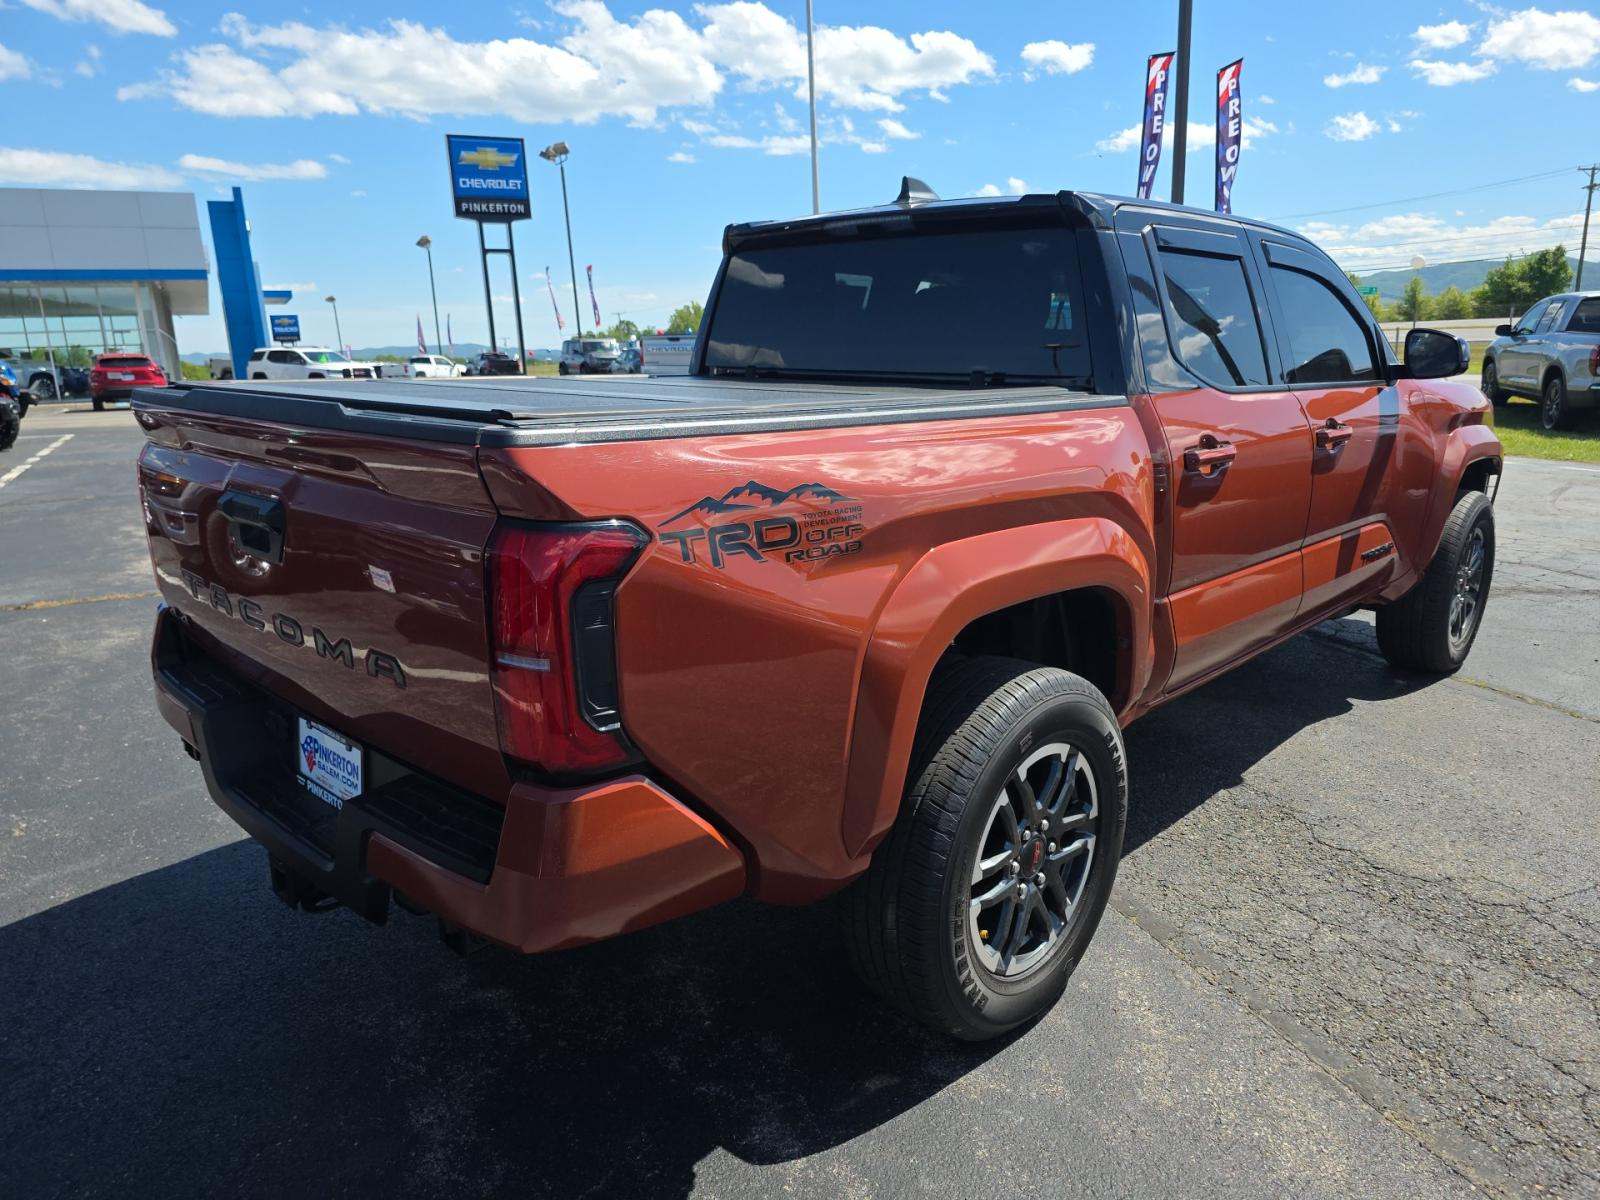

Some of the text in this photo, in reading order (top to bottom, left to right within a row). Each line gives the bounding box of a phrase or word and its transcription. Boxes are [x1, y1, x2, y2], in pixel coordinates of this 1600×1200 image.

[1152, 70, 1166, 134] PRE
[1227, 78, 1240, 138] PRE
[459, 177, 522, 190] CHEVROLET
[461, 202, 525, 214] PINKERTON
[802, 505, 863, 520] TOYOTA RACING
[803, 514, 863, 529] DEVELOPMENT
[658, 516, 864, 570] TRD OFF
[784, 540, 864, 564] ROAD
[180, 568, 408, 690] TACOMA
